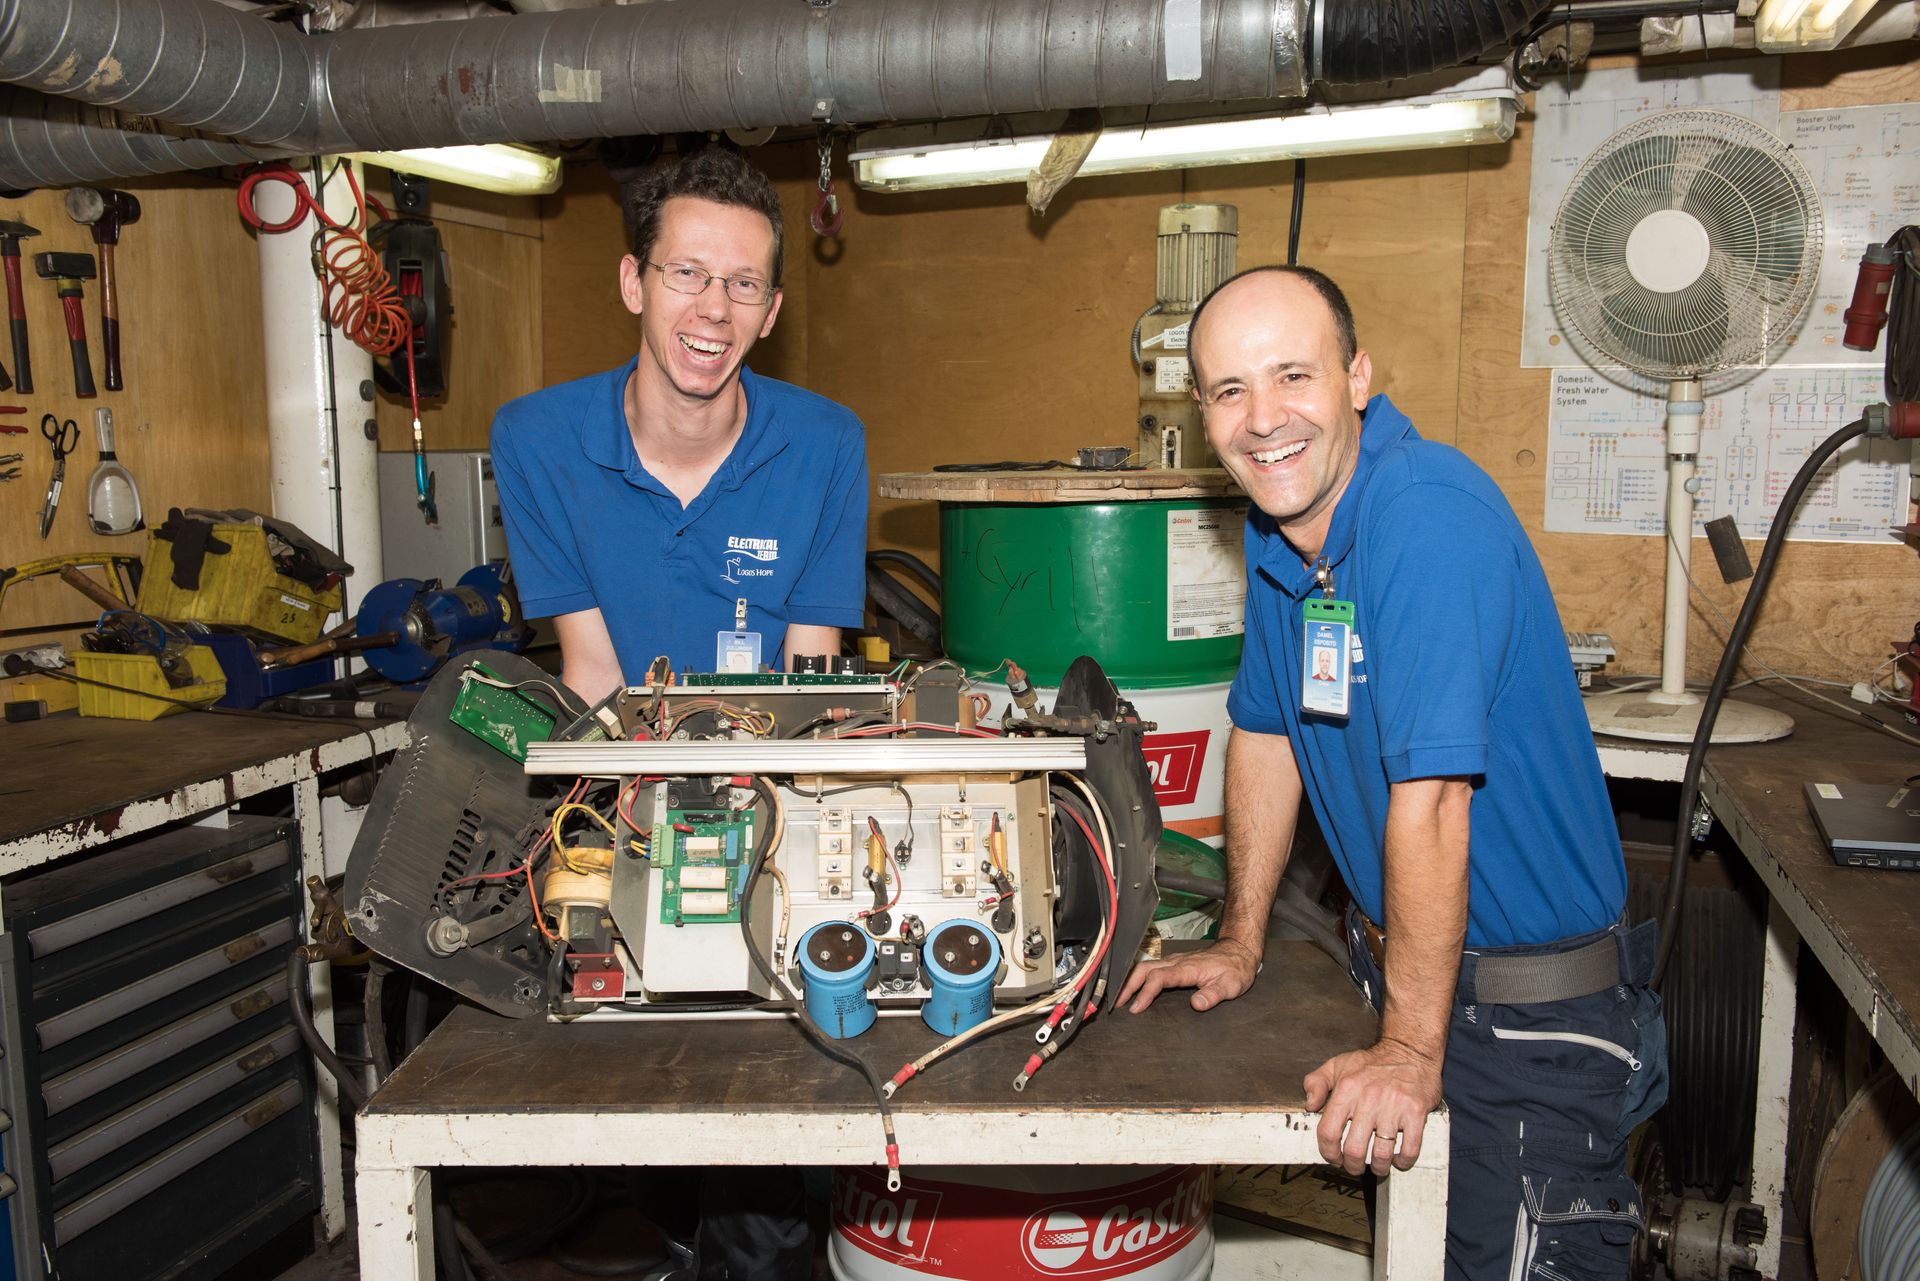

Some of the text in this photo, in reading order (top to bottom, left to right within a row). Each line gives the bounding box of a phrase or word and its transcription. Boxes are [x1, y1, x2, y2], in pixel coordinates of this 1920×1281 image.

[1796, 116, 1824, 124] Booster
[1557, 375, 1595, 383] Domestic
[1557, 386, 1609, 394] Fresh Water
[1557, 397, 1587, 407] System
[737, 568, 774, 577] LOGOS HOPE
[929, 1258, 943, 1266] TM
